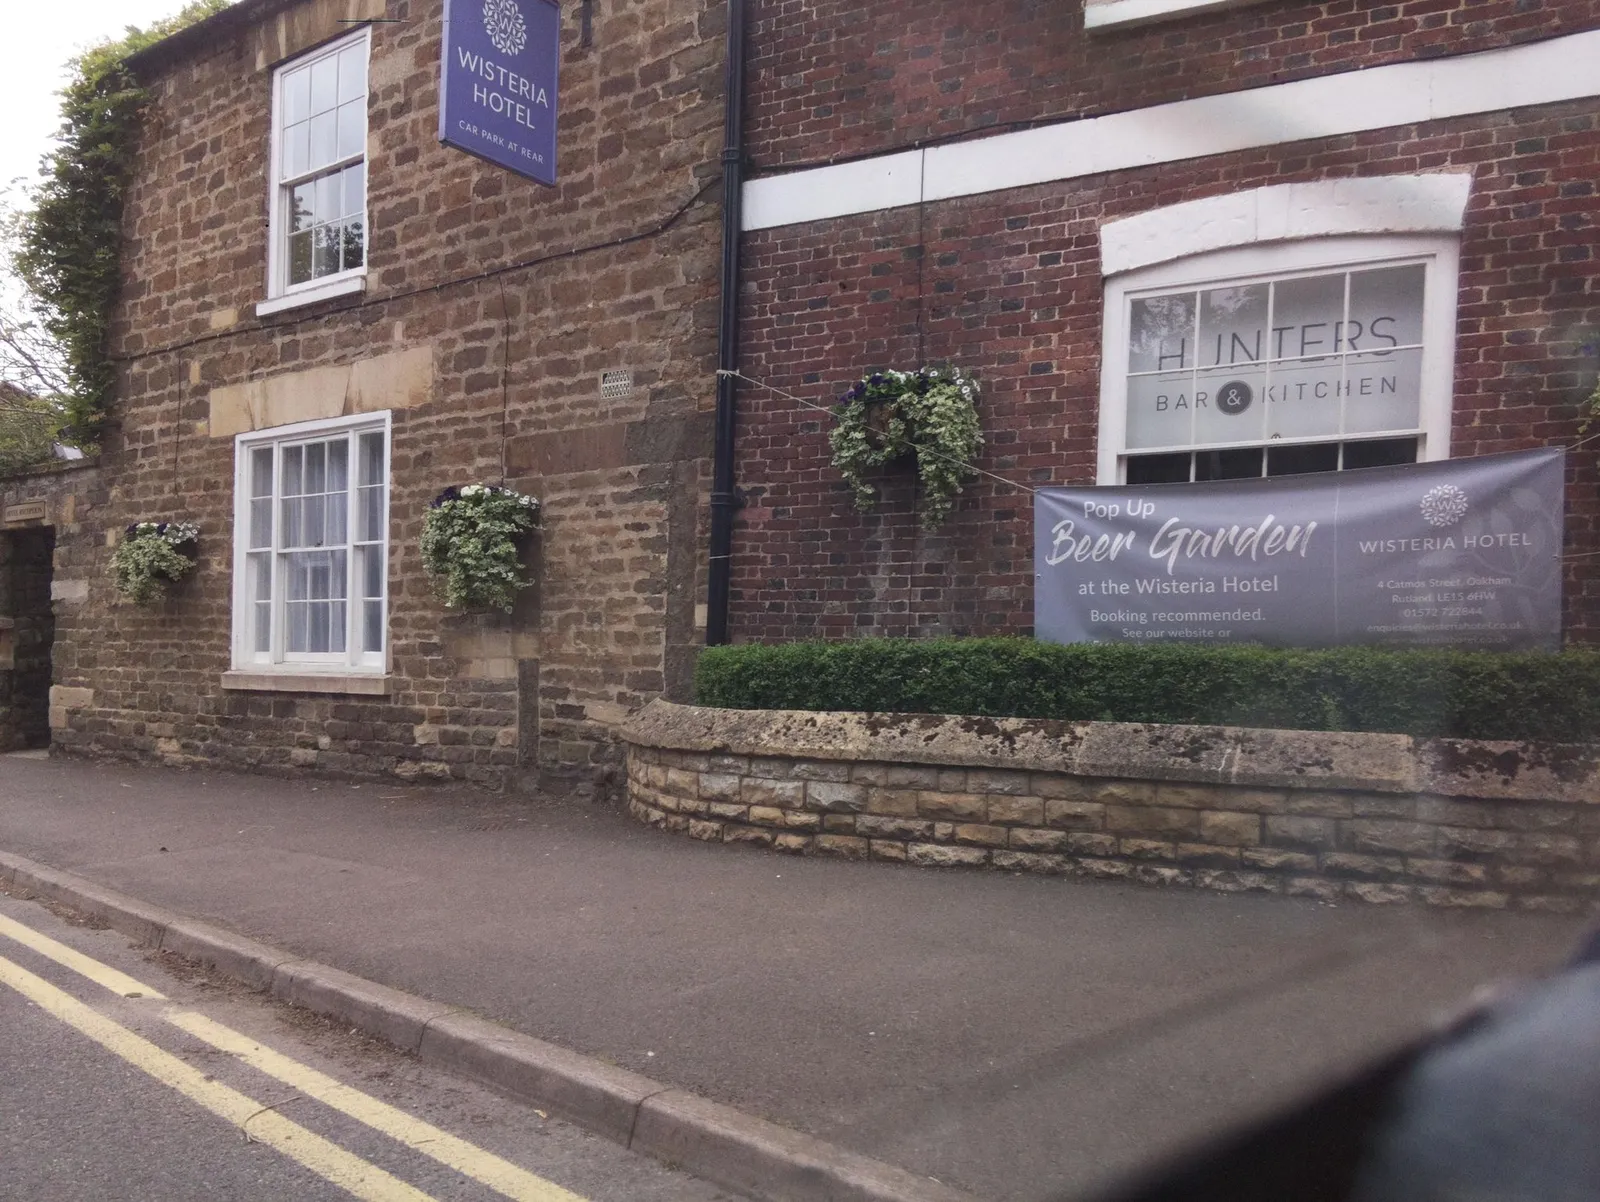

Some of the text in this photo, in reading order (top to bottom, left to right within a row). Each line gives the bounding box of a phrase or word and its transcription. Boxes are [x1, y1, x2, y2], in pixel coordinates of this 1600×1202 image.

[499, 18, 513, 32] W
[458, 46, 549, 108] WISTERIA
[473, 83, 536, 129] HOTEL
[458, 119, 544, 164] CAR PARK AT REAR
[1157, 316, 1399, 374] HUNTERS
[1156, 391, 1209, 412] BAR
[1261, 375, 1397, 404] KITCHEN
[1083, 499, 1156, 520] Pop Up
[1045, 514, 1318, 575] Beer Garden
[1359, 533, 1532, 553] WISTERIA HOTEL
[1078, 575, 1279, 595] at the Wisteria Hotel
[1466, 576, 1512, 586] Oakham
[1090, 608, 1266, 625] Booking recommended.
[1122, 628, 1232, 639] See our website or
